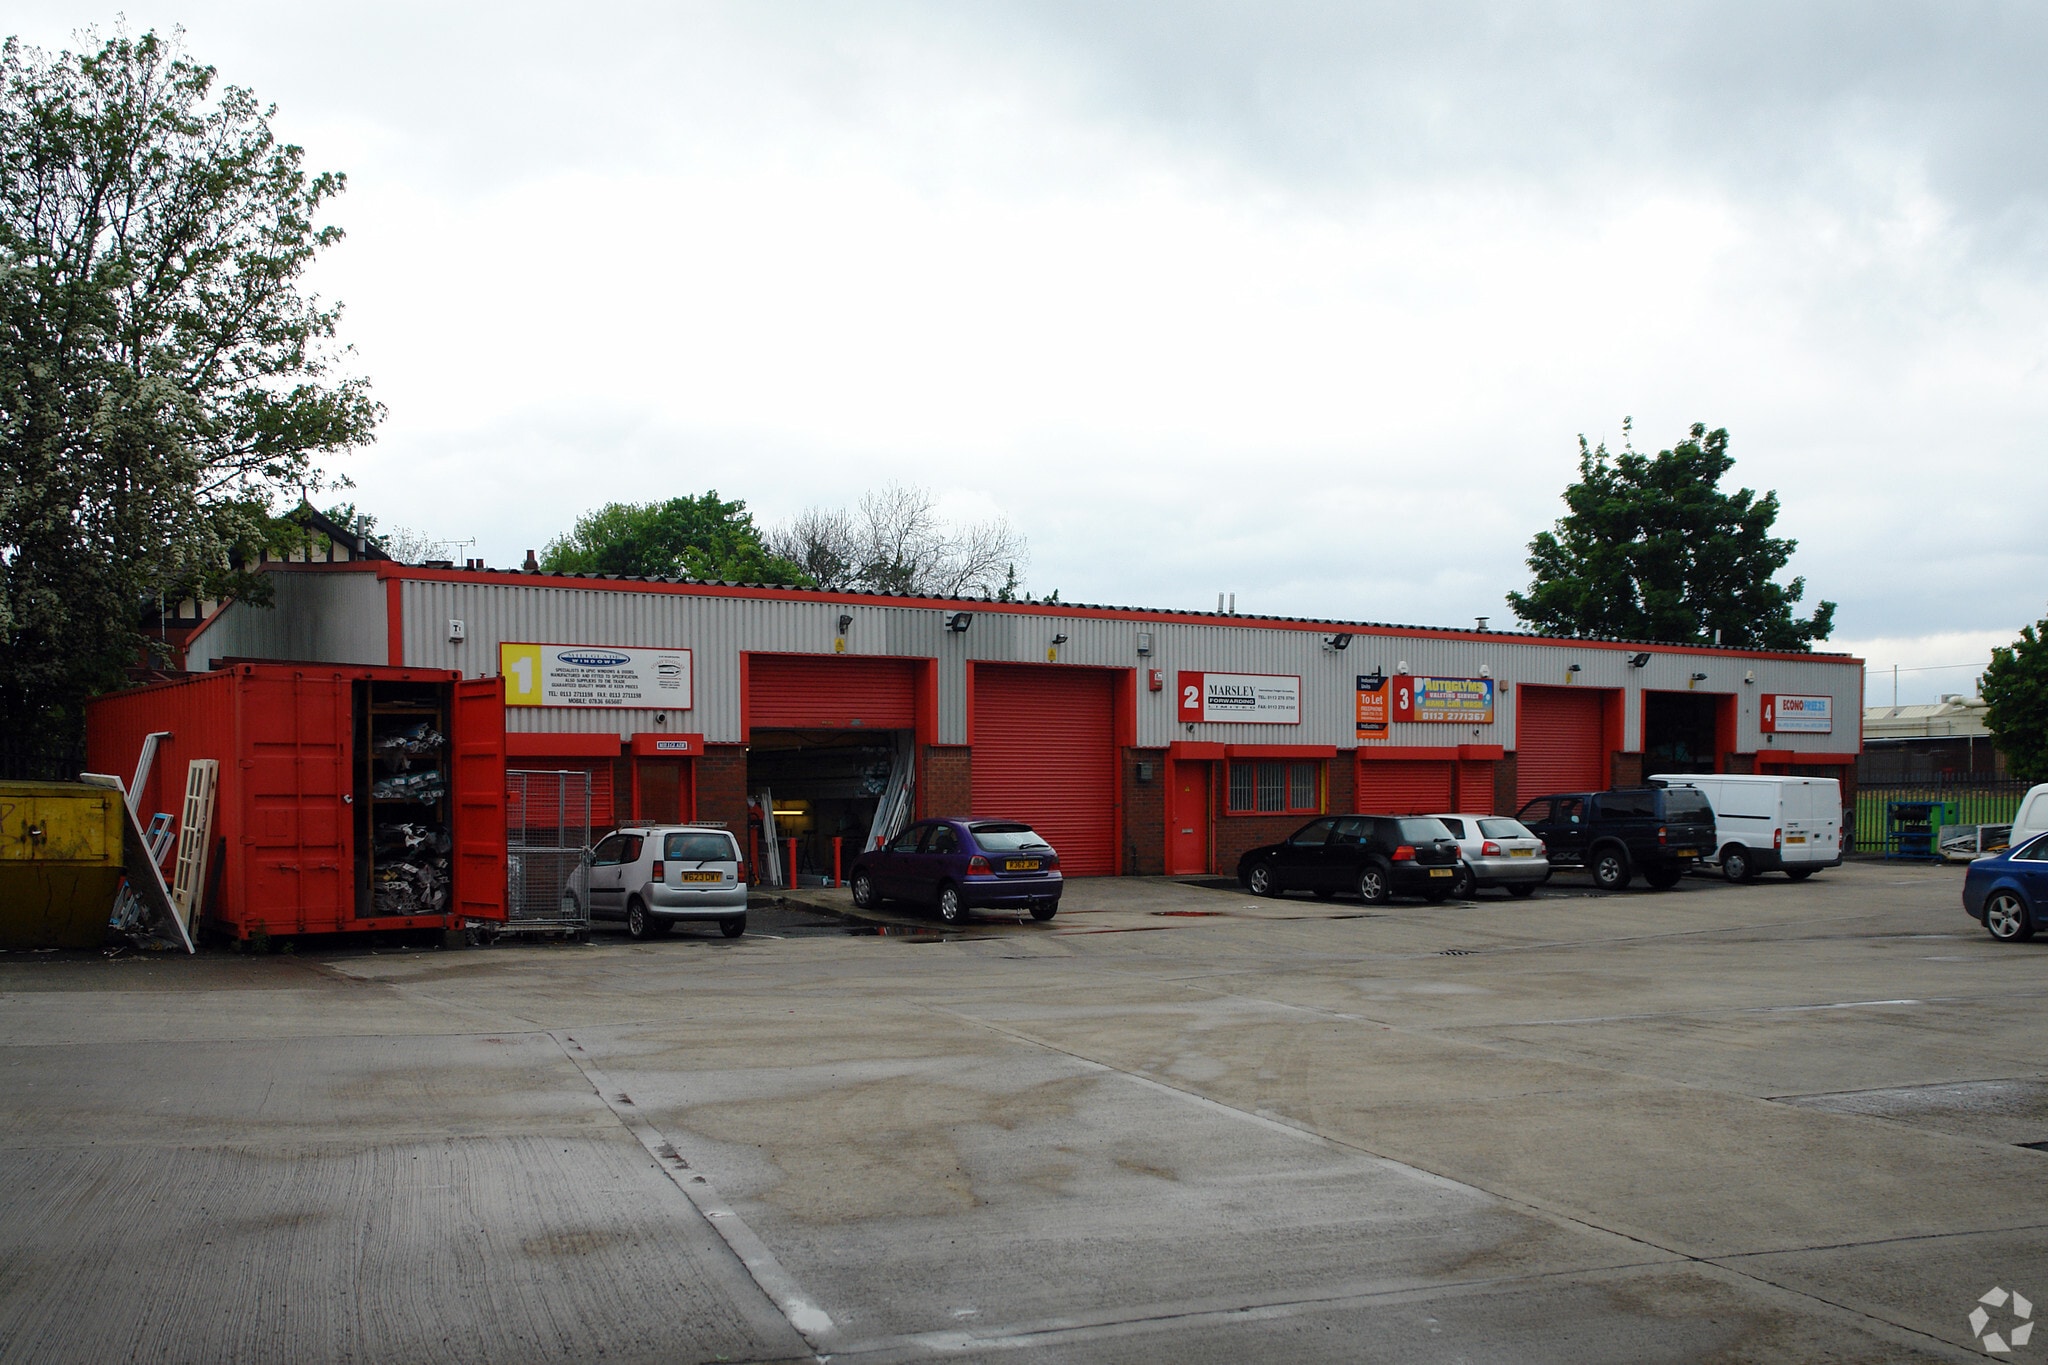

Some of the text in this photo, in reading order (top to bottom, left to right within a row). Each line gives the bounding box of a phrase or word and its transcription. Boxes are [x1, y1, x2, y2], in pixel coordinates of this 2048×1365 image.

[511, 656, 533, 694] 1
[1184, 685, 1199, 709] 2
[1209, 684, 1256, 696] MARSLEY
[1361, 694, 1383, 705] To Let
[1400, 688, 1409, 710] 3
[1422, 712, 1485, 721] 0113 2771367
[1765, 704, 1772, 722] 4
[684, 873, 704, 881] W623
